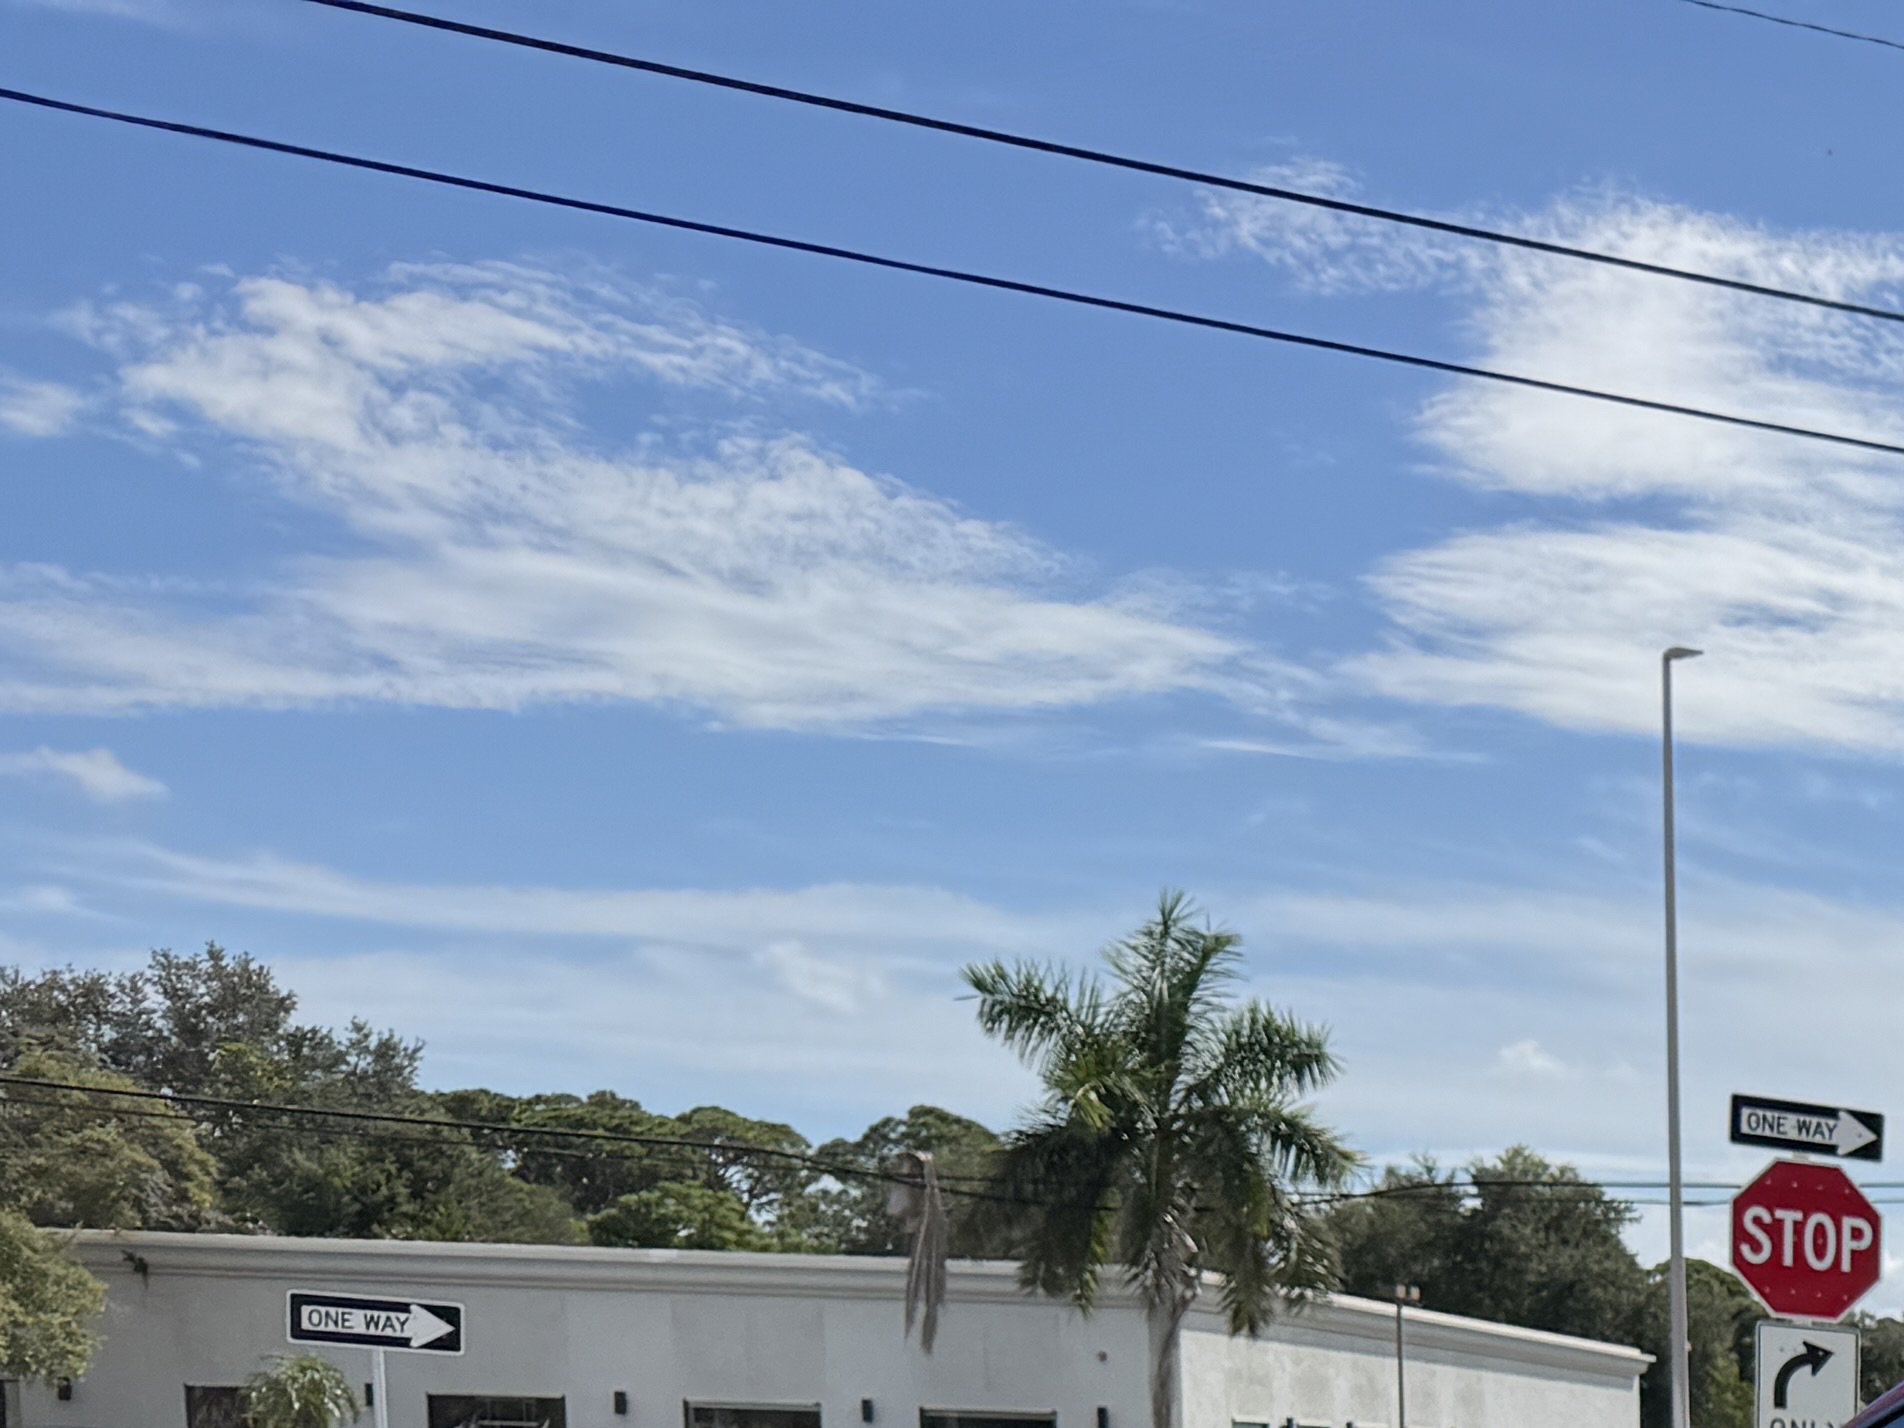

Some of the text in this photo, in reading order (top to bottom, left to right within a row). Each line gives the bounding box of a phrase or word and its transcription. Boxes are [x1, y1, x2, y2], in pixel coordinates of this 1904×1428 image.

[1747, 1112, 1837, 1141] ONE WAY
[1739, 1205, 1873, 1273] STOP
[307, 1308, 409, 1333] ONE WAY
